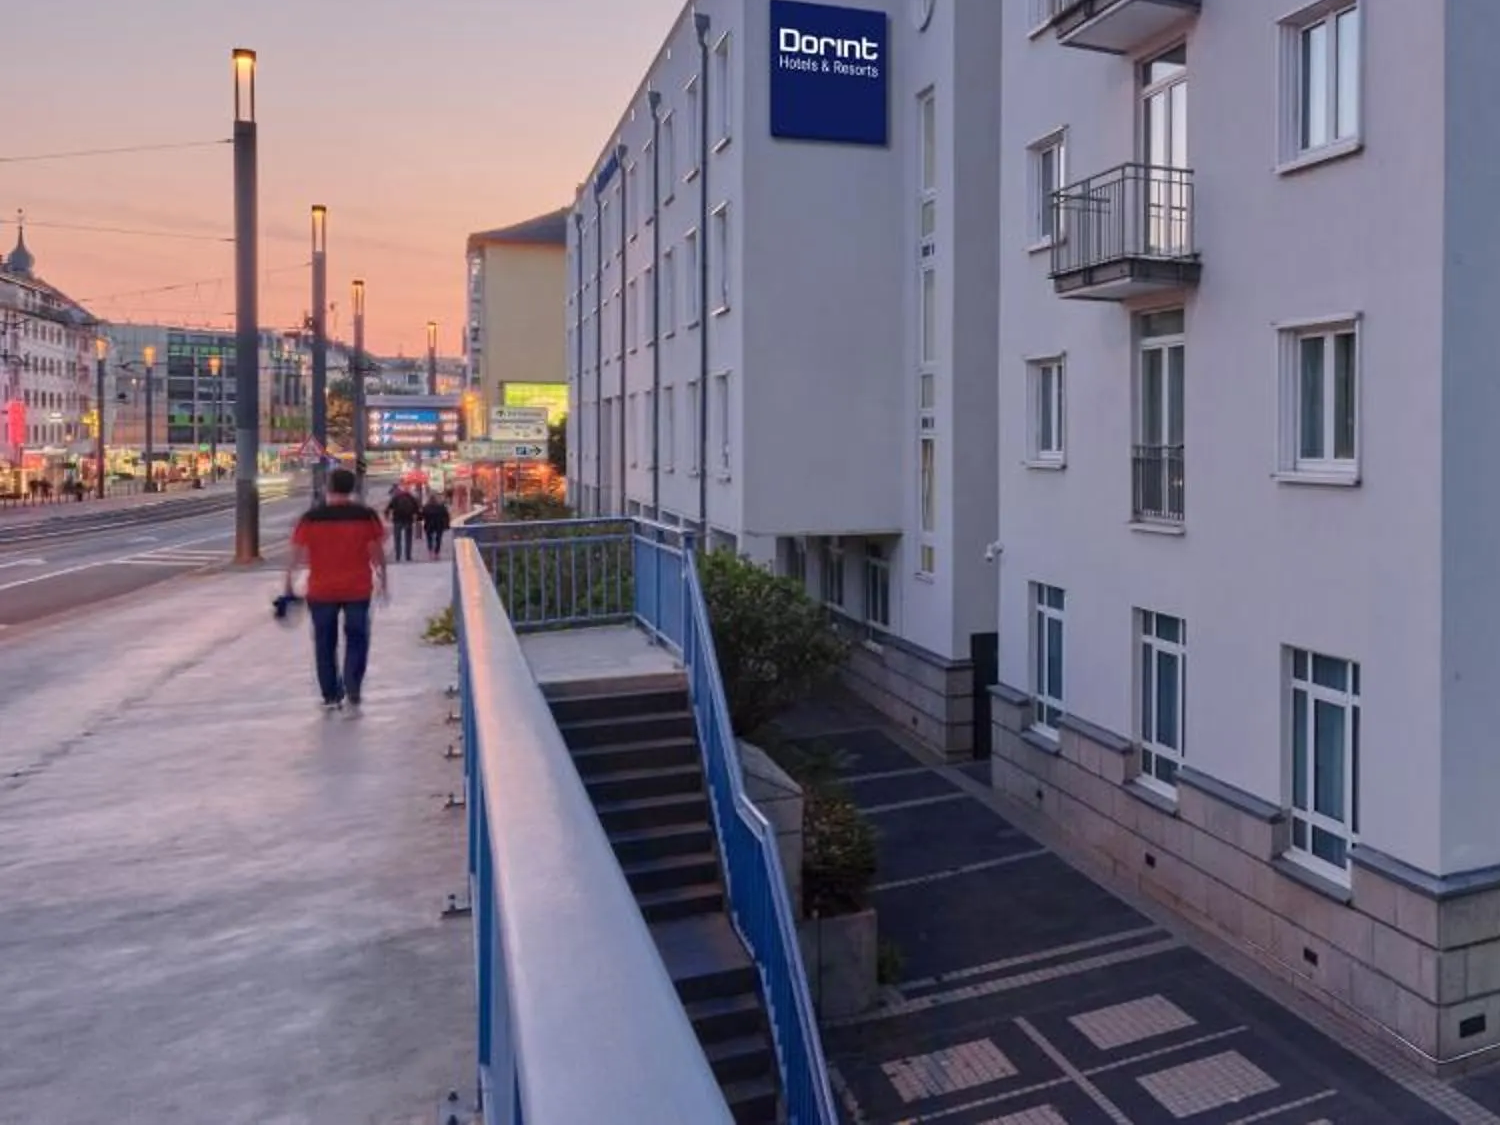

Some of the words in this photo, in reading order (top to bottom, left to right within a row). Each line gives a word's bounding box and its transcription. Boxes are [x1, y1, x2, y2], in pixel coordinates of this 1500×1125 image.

[779, 27, 879, 61] Dorint
[779, 55, 819, 72] Hotels
[821, 59, 830, 72] &
[833, 60, 879, 78] Resorts
